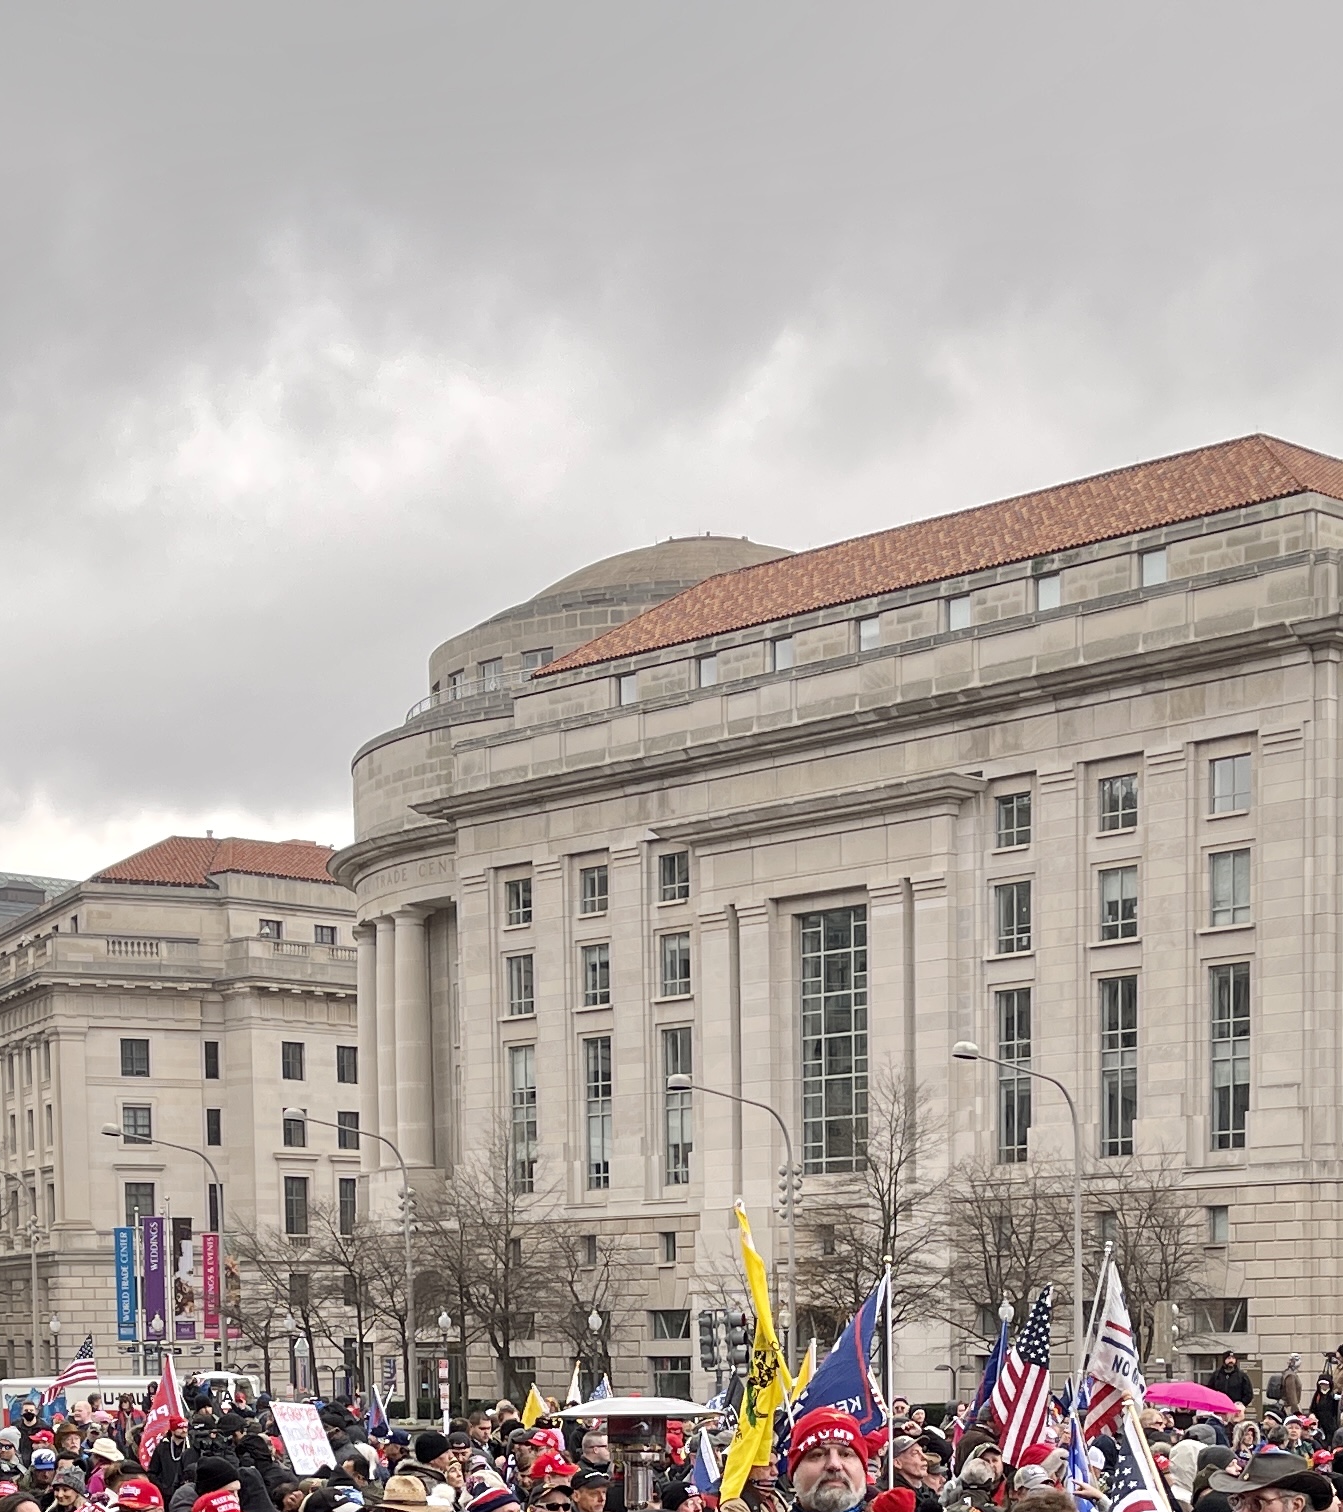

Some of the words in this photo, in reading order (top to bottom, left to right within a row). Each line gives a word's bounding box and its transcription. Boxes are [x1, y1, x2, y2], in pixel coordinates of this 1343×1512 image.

[375, 867, 408, 889] TRADE
[418, 858, 456, 878] CENT
[119, 1231, 129, 1264] CENTER
[149, 1221, 159, 1271] WEDDINGS
[206, 1236, 214, 1266] EVENTS
[120, 1265, 129, 1290] TRADE
[207, 1267, 214, 1275] &
[121, 1291, 131, 1322] WORLD
[1111, 1353, 1131, 1377] NO
[798, 1427, 854, 1452] TRUMP
